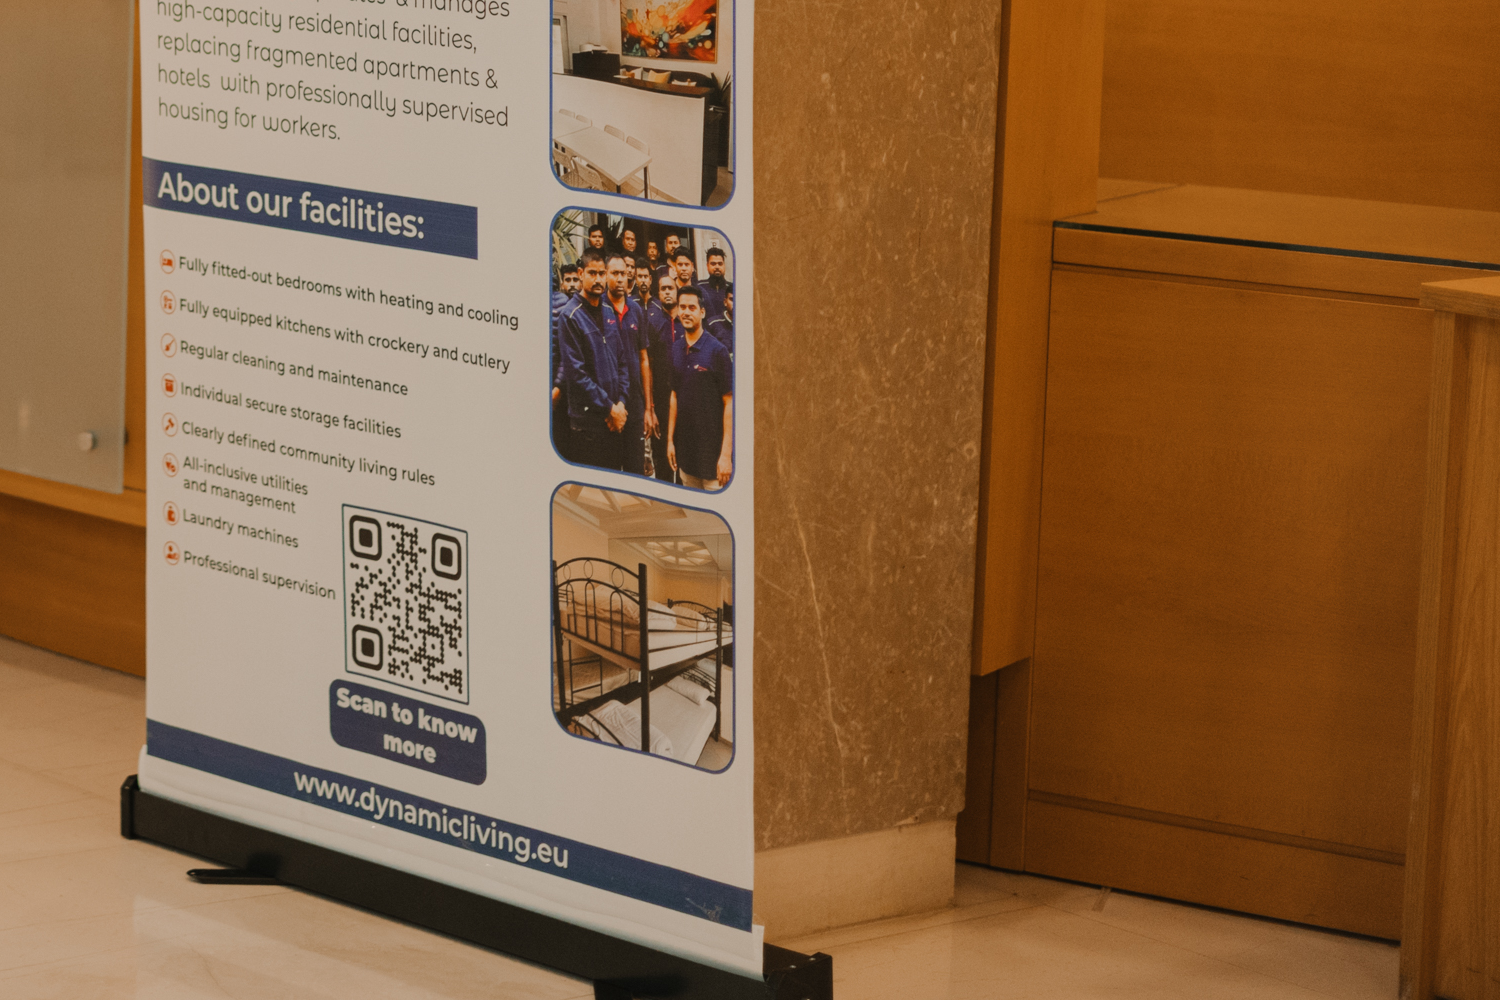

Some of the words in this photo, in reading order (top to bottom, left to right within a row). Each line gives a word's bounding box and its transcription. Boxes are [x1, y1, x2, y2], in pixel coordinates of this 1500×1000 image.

[157, 31, 241, 62] replacing
[247, 39, 357, 72] fragmented
[363, 60, 479, 88] apartments
[485, 68, 498, 89] &
[288, 12, 387, 41] residential
[392, 20, 478, 54] facilities,
[158, 63, 210, 89] hotels
[220, 72, 260, 96] with
[266, 78, 396, 118] professionally
[402, 96, 509, 128] supervised
[158, 97, 228, 129] housing
[234, 107, 256, 129] for
[262, 116, 341, 141] workers.
[158, 171, 239, 211] About
[246, 191, 292, 218] our
[299, 191, 425, 240] facilities:
[179, 256, 209, 276] Fully
[212, 261, 272, 286] fitted-out
[276, 271, 342, 297] bedrooms
[346, 286, 375, 303] with
[380, 291, 434, 315] heating
[438, 300, 464, 318] and
[467, 306, 519, 331] cooling
[179, 298, 209, 318] Fully
[212, 306, 272, 328] equipped
[276, 315, 331, 339] kitchens
[334, 327, 364, 345] with
[368, 334, 429, 358] crockery
[433, 343, 458, 362] and
[462, 350, 511, 374] cutlery
[180, 340, 229, 361] Regular
[232, 351, 285, 376] cleaning
[289, 362, 314, 379] and
[318, 369, 408, 396] maintenance
[181, 382, 242, 406] Individual
[245, 397, 287, 417] secure
[291, 406, 339, 429] storage
[343, 414, 401, 439] facilities
[182, 421, 224, 445] Clearly
[228, 432, 276, 453] defined
[279, 442, 355, 473] community
[359, 457, 397, 481] living
[401, 468, 435, 487] rules
[183, 456, 258, 485] All-inclusive
[261, 473, 308, 496] utilities
[183, 476, 208, 494] and
[211, 486, 296, 514] management
[183, 508, 234, 536] Laundry
[238, 522, 299, 549] machines
[183, 551, 258, 581] Professional
[262, 569, 336, 601] supervision
[336, 687, 388, 720] Scan
[391, 702, 414, 725] to
[417, 708, 478, 745] know
[383, 731, 437, 765] more
[293, 770, 570, 870] www.dynamicliving.eu
